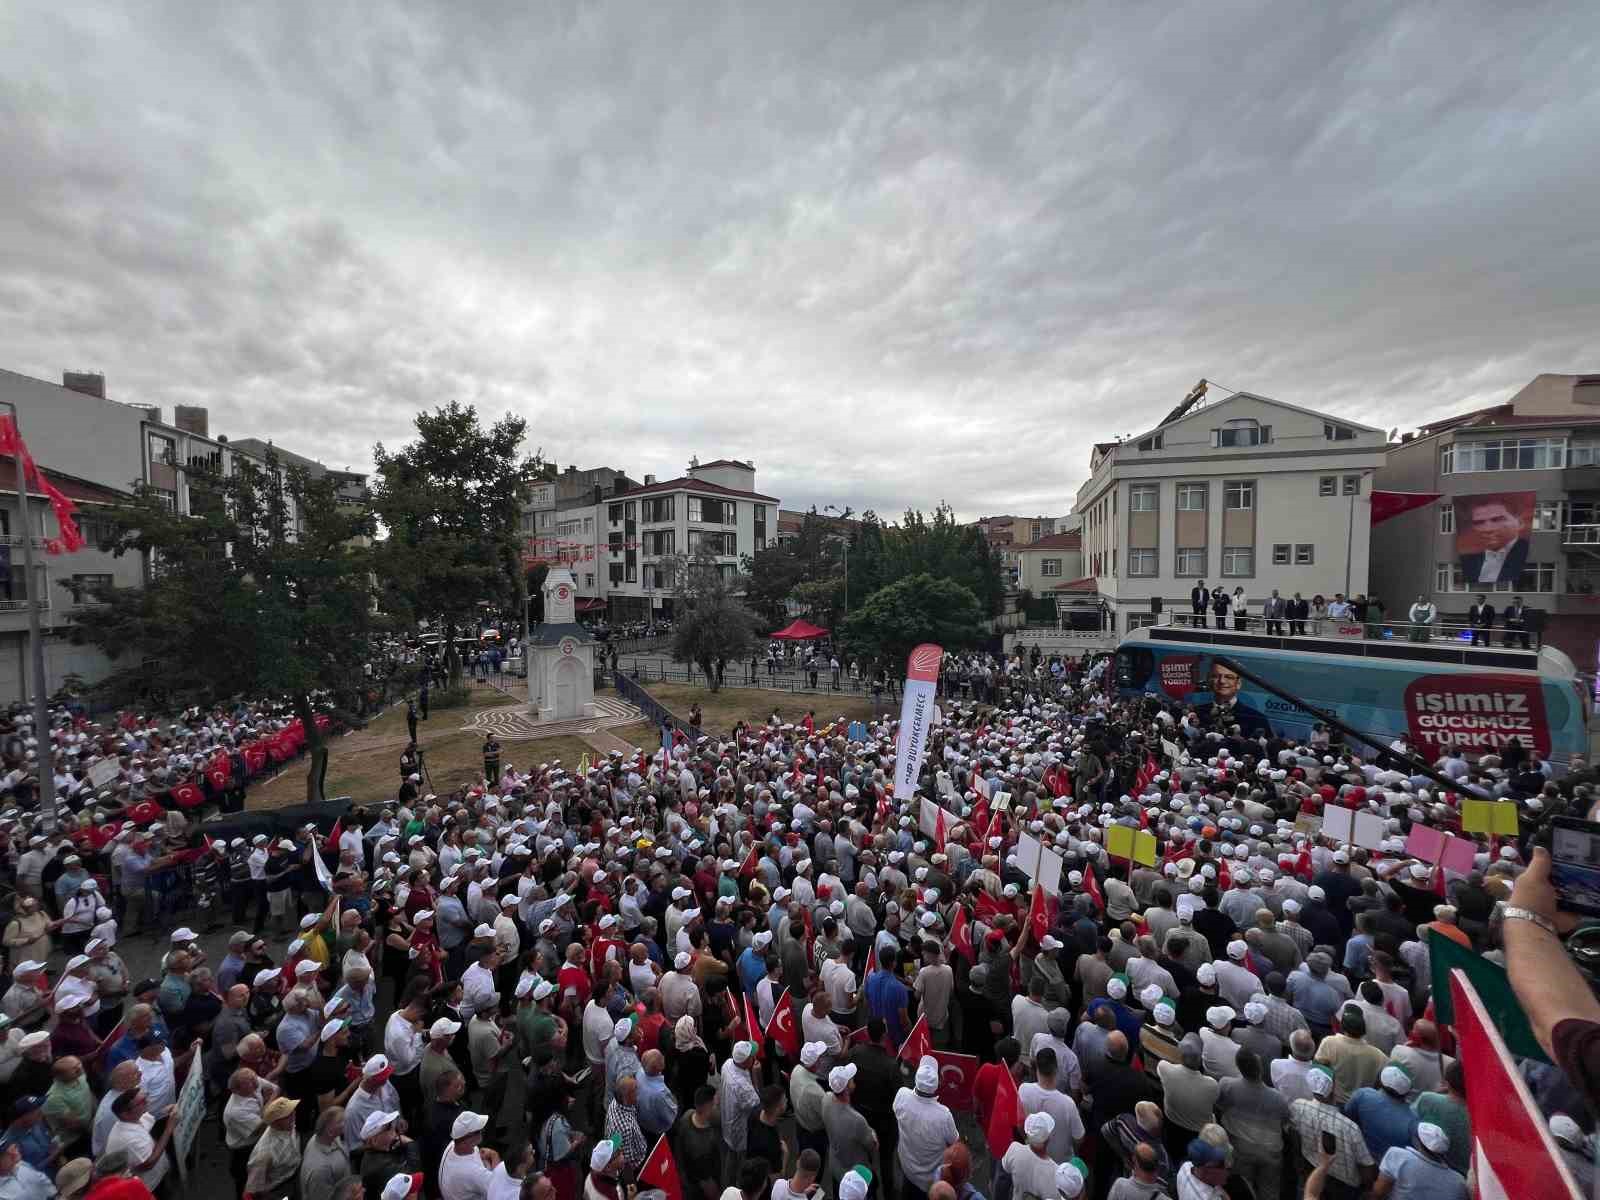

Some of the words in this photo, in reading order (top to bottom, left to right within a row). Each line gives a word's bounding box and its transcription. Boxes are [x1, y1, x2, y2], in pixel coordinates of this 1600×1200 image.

[1338, 626, 1361, 635] CHP
[1418, 714, 1532, 729] GÜCÜMÜZ
[1421, 730, 1535, 748] TÜRKİYE
[905, 762, 914, 784] CHP
